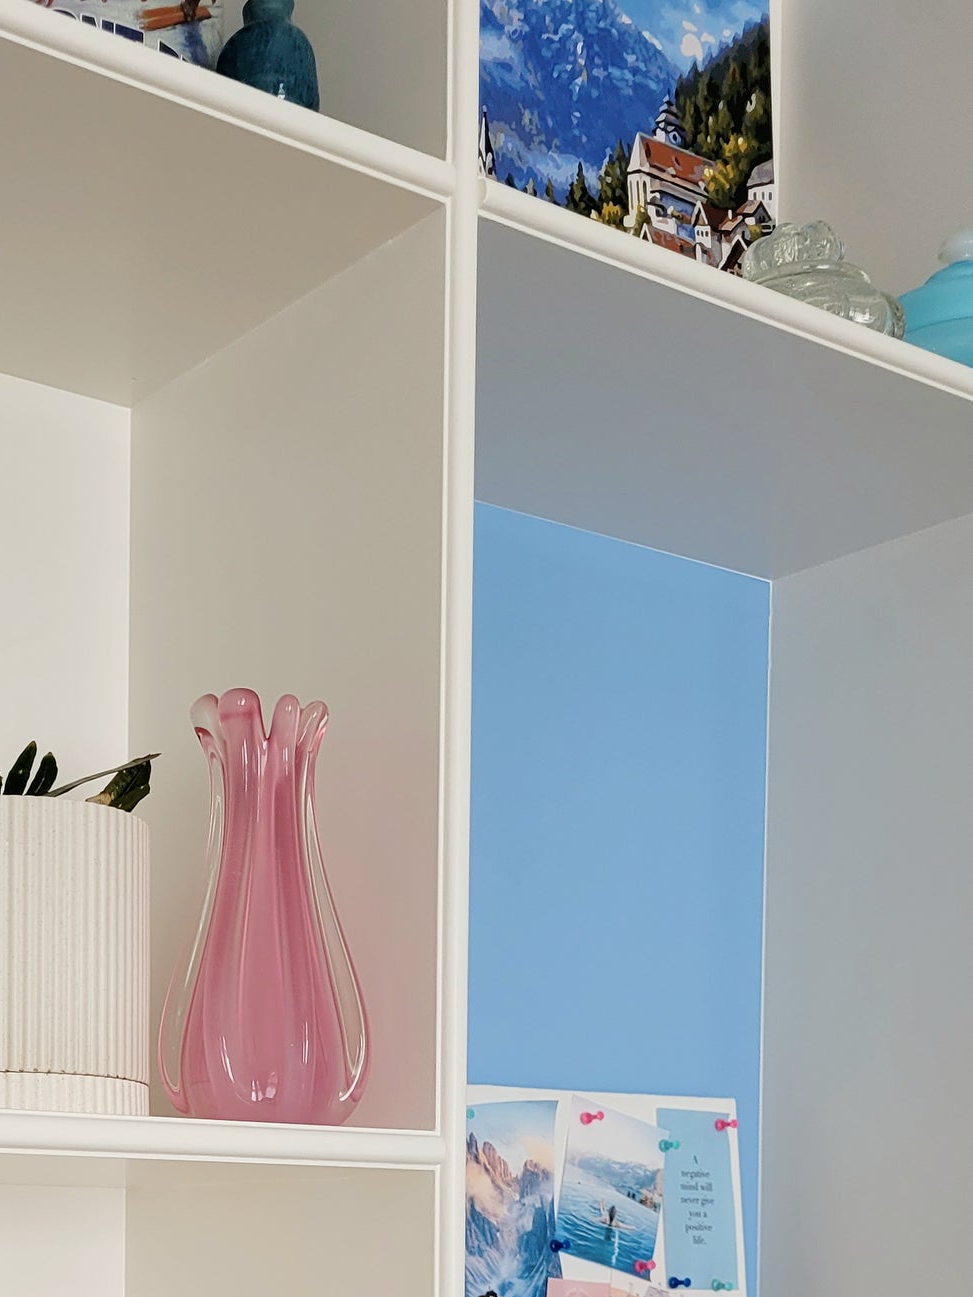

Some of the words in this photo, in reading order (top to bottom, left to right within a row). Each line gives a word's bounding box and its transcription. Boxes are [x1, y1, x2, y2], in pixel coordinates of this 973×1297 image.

[680, 1168, 711, 1180] negative
[680, 1181, 699, 1192] mind
[700, 1181, 714, 1192] will
[680, 1196, 699, 1204] never
[700, 1196, 715, 1207] give
[688, 1210, 702, 1221] you
[684, 1221, 713, 1234] positive
